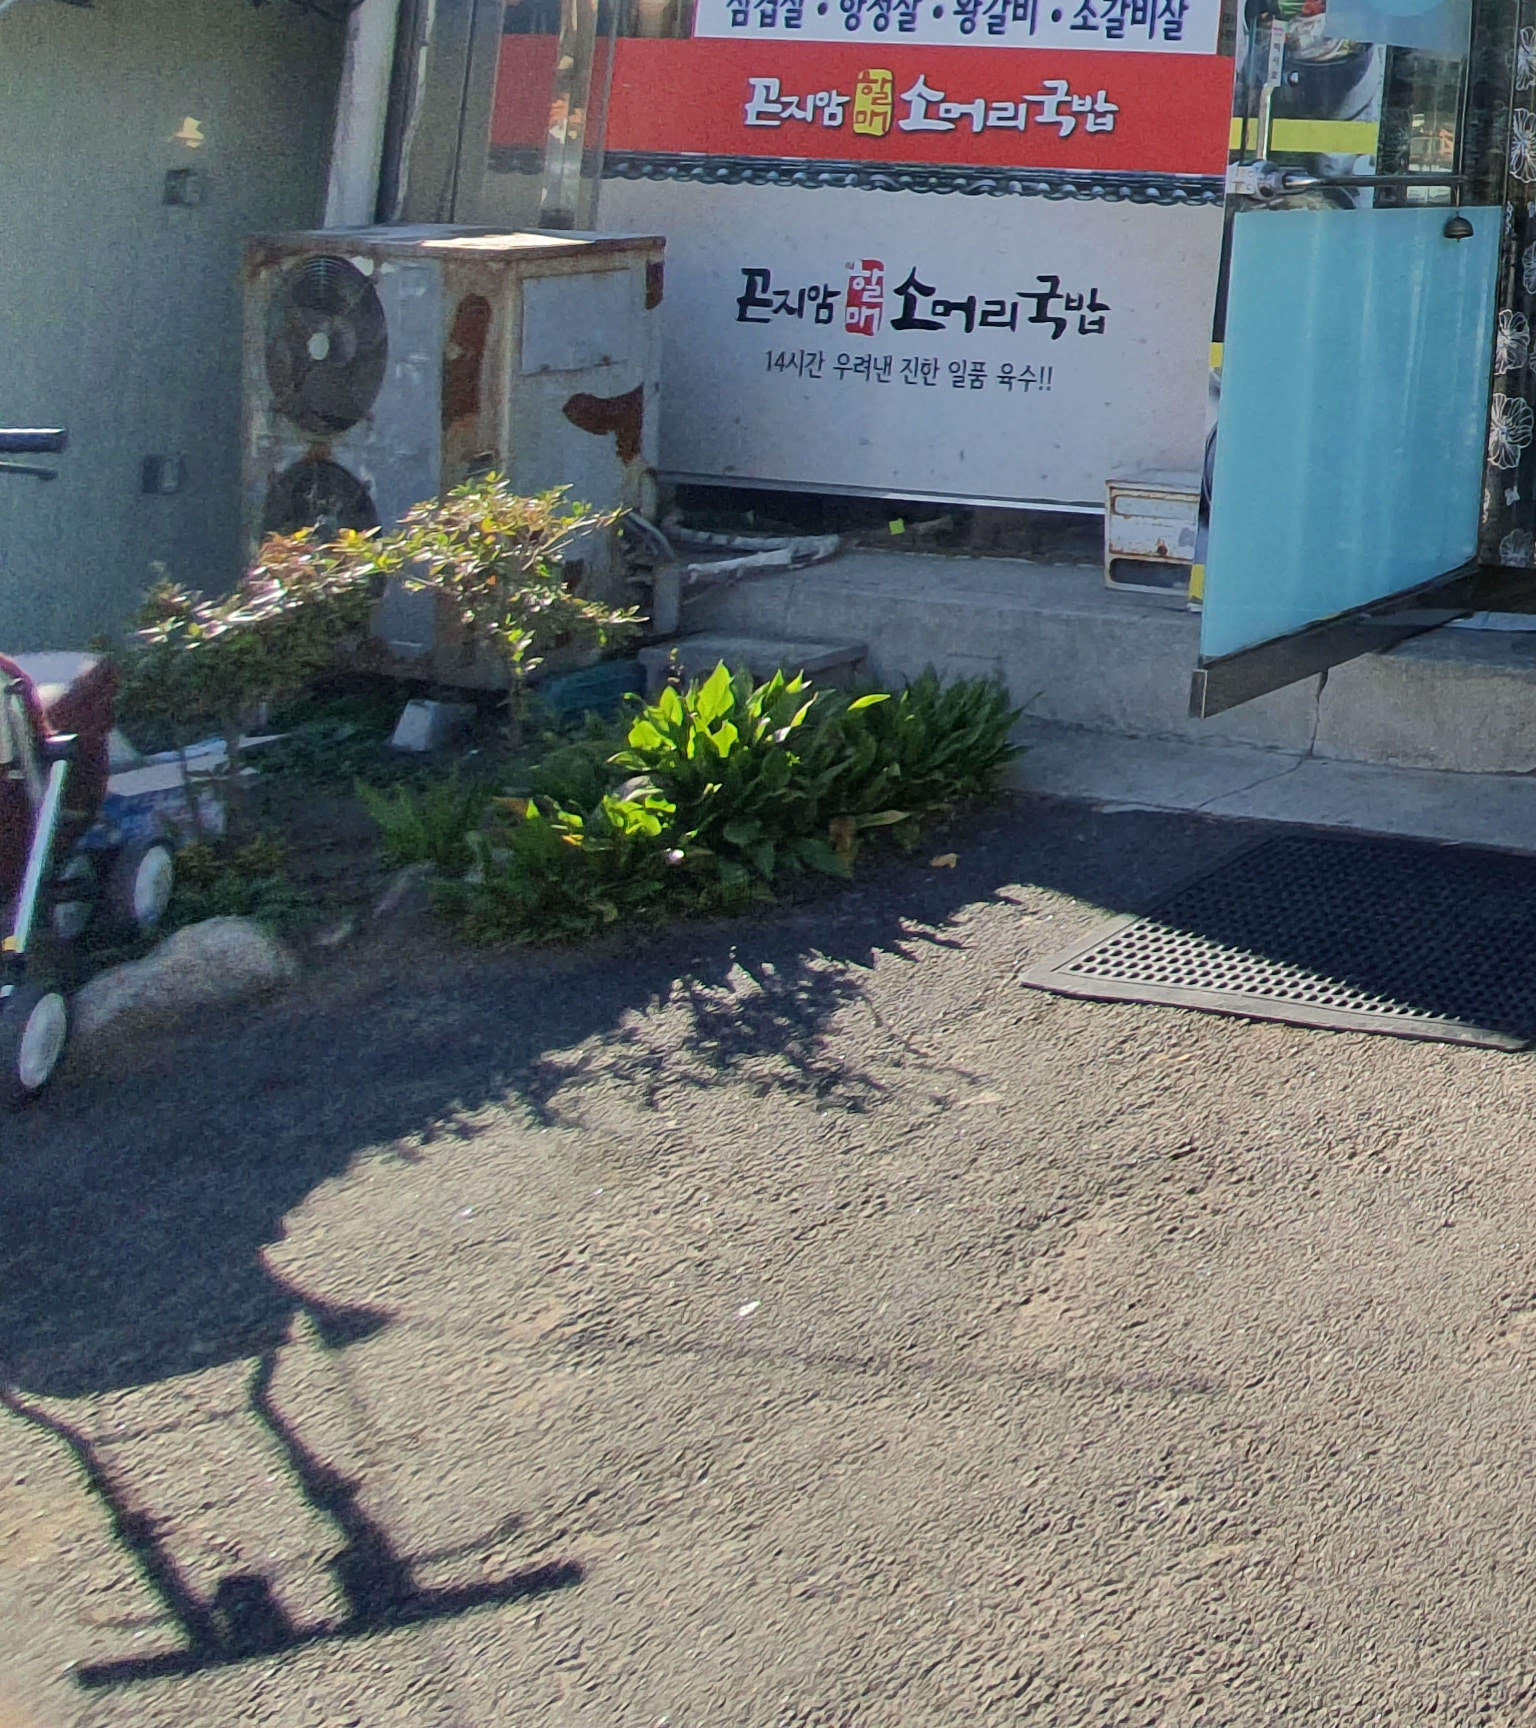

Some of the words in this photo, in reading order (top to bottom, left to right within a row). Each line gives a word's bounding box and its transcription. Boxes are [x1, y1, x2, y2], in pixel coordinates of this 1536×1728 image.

[745, 76, 850, 128] 곤지암
[898, 73, 1119, 138] 소머리국밥
[735, 266, 842, 325] 곤지암
[890, 266, 1112, 340] 소머리국밥
[765, 349, 826, 380] 14시간
[833, 352, 893, 385] 우려낸
[900, 357, 940, 387] 진한
[948, 359, 989, 391] 일품
[996, 361, 1053, 393] 육수!!
